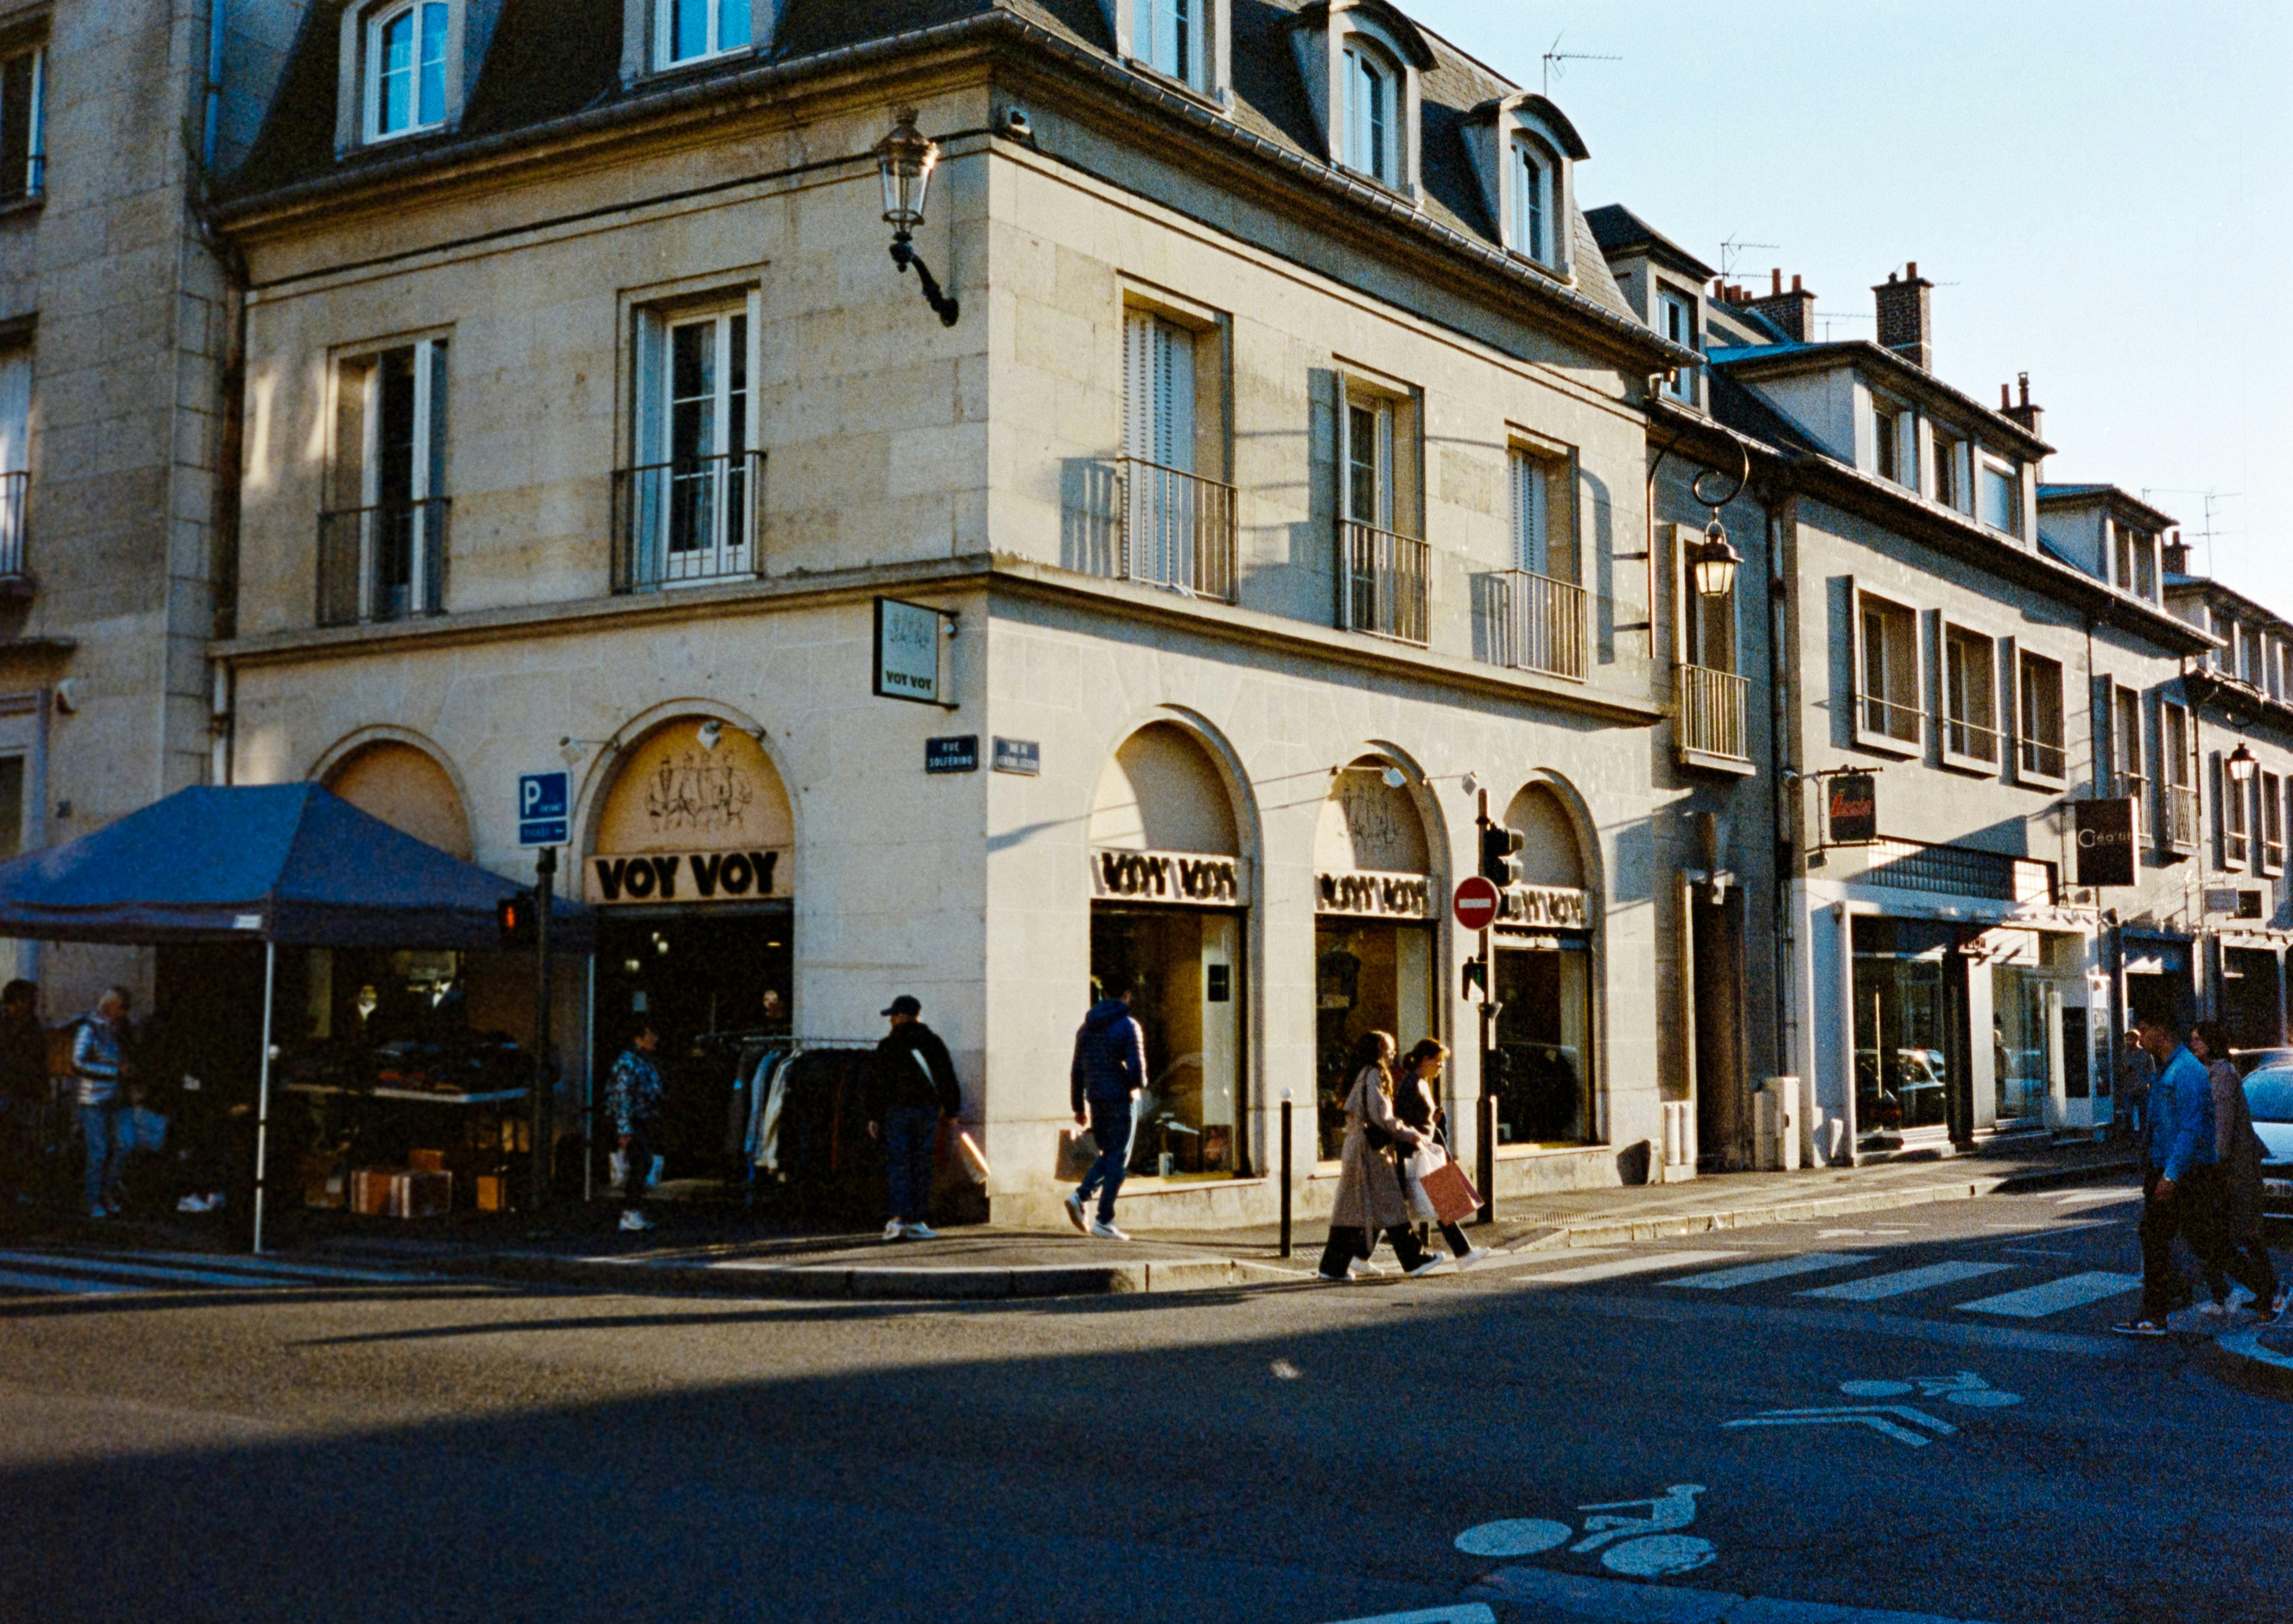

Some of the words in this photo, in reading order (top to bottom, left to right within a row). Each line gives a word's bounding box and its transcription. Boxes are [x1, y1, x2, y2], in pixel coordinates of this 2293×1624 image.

[886, 669, 907, 686] VOY
[911, 675, 931, 690] VOY
[942, 742, 959, 752] RUE
[524, 780, 541, 815] P
[595, 856, 679, 900] VOY
[689, 851, 778, 896] VOY
[1102, 852, 1170, 896] VOY
[1178, 858, 1237, 899] VOY
